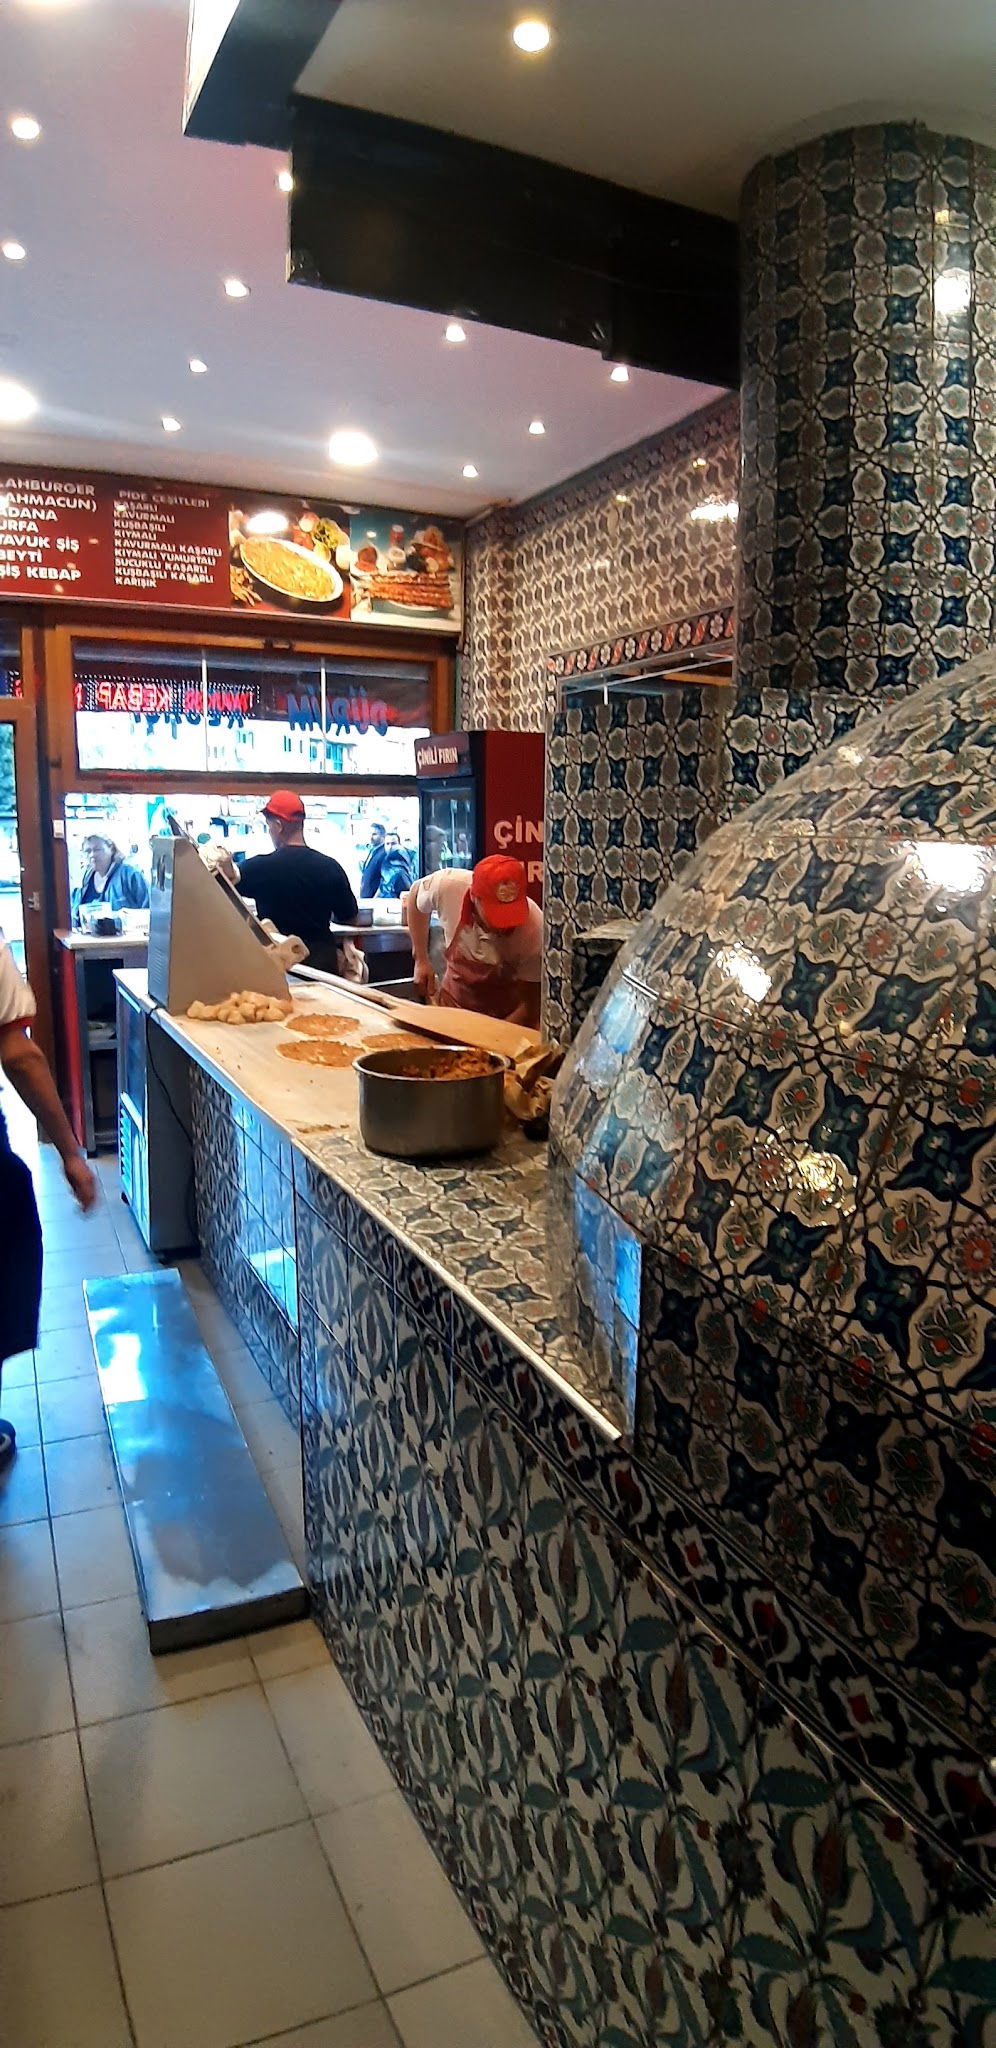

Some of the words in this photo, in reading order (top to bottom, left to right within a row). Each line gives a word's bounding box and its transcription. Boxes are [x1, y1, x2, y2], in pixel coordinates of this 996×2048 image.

[0, 478, 95, 496] AHBURGER
[113, 510, 175, 524] KAVURMALI
[114, 519, 166, 533] KUŞBAŞILI
[114, 529, 157, 541] KIYMALI
[56, 536, 80, 553] ŞİŞ
[114, 538, 176, 552] KAVURMALI
[179, 544, 222, 557] KAŞARLI
[114, 548, 157, 560] KIYMALI
[160, 552, 216, 566] YUMURTALI
[26, 565, 82, 581] KEBAP
[115, 557, 161, 570] SUCUKLU
[165, 562, 208, 575] KAŞARLI
[115, 566, 167, 579] KUŞBAŞILI
[170, 571, 214, 584] KAŞARLI
[115, 576, 157, 589] KARIŞIK
[417, 745, 438, 770] ÇİNİLİ
[438, 747, 459, 764] FIRIN
